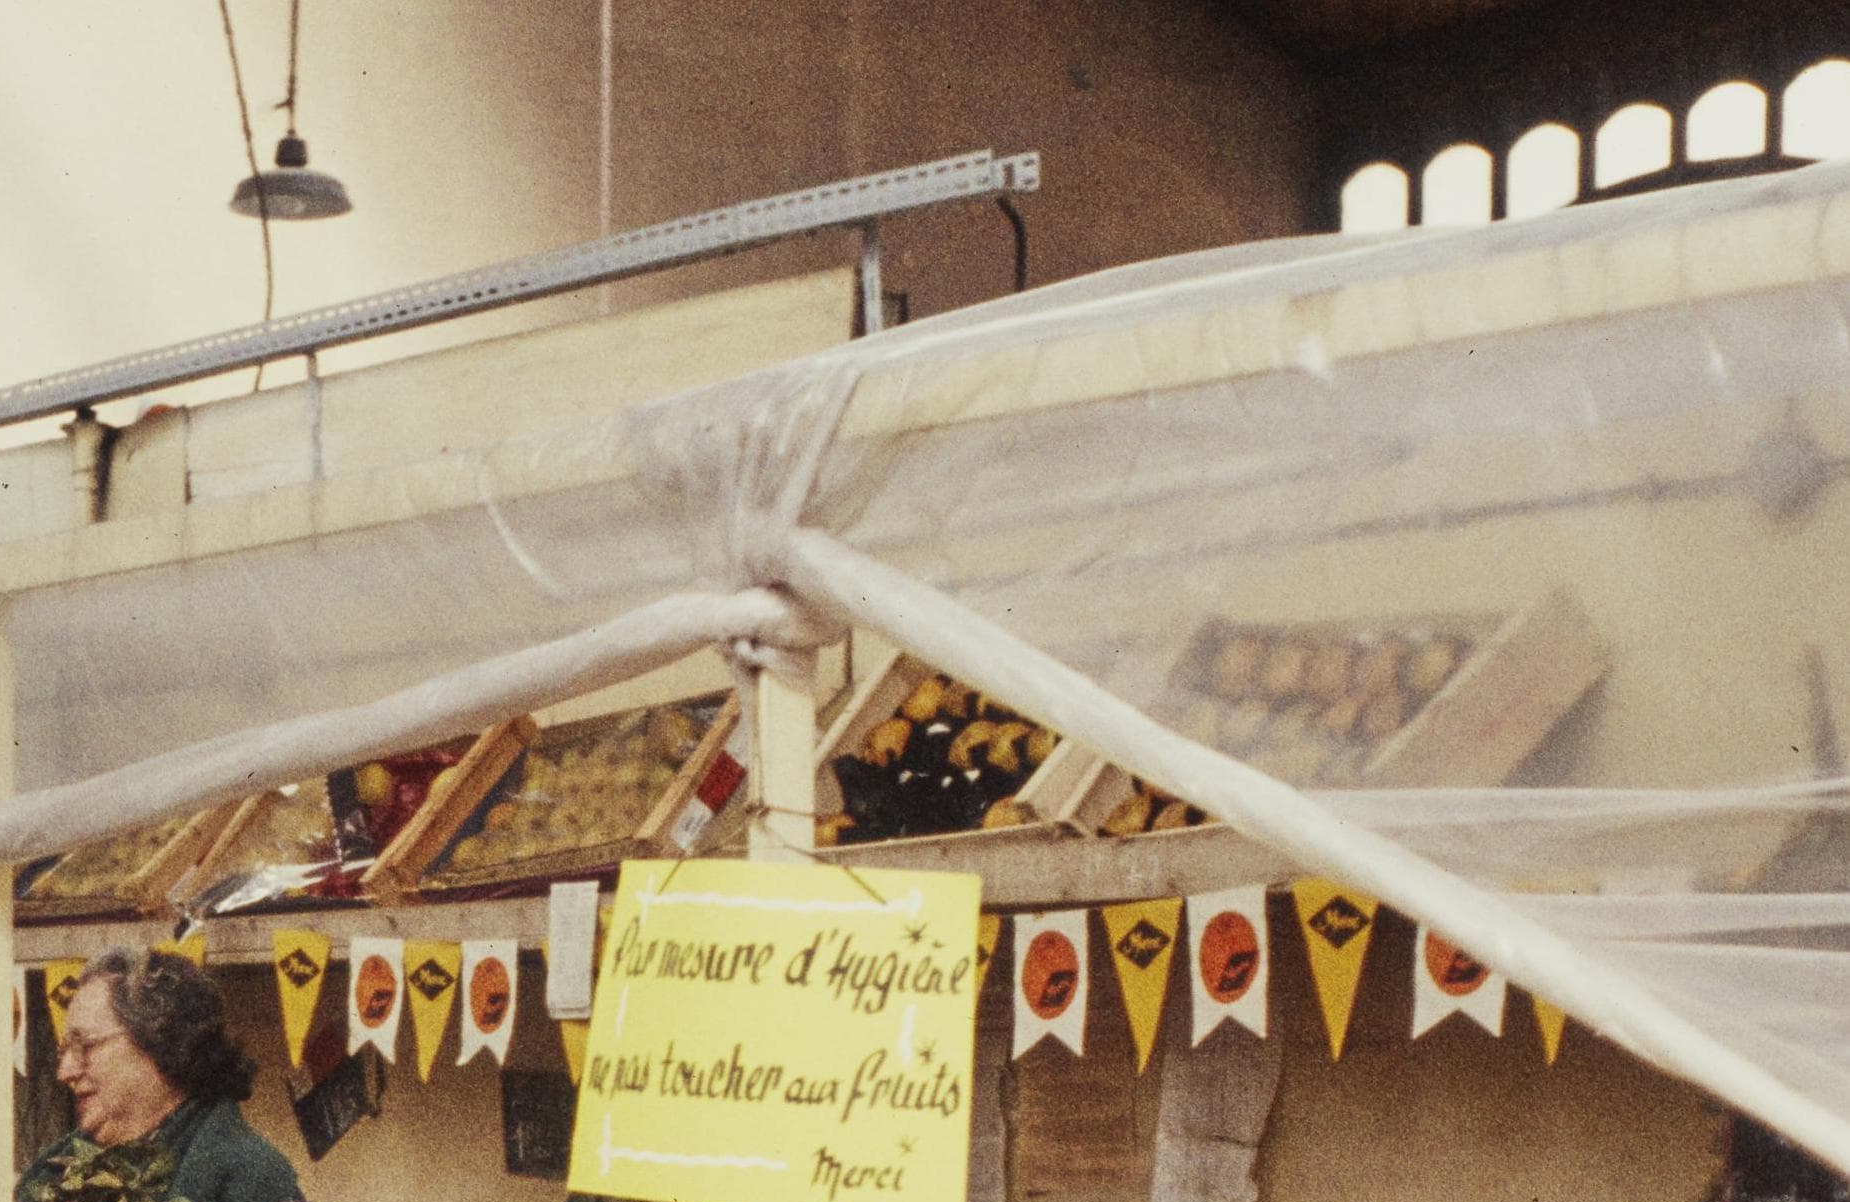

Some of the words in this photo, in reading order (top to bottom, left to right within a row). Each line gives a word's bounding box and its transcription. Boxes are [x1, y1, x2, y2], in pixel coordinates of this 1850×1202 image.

[613, 917, 656, 979] Par
[657, 938, 776, 985] mesure
[661, 1040, 784, 1102] toucher
[784, 1076, 839, 1106] aux
[841, 1044, 962, 1123] fruits
[811, 1138, 910, 1201] Merci
